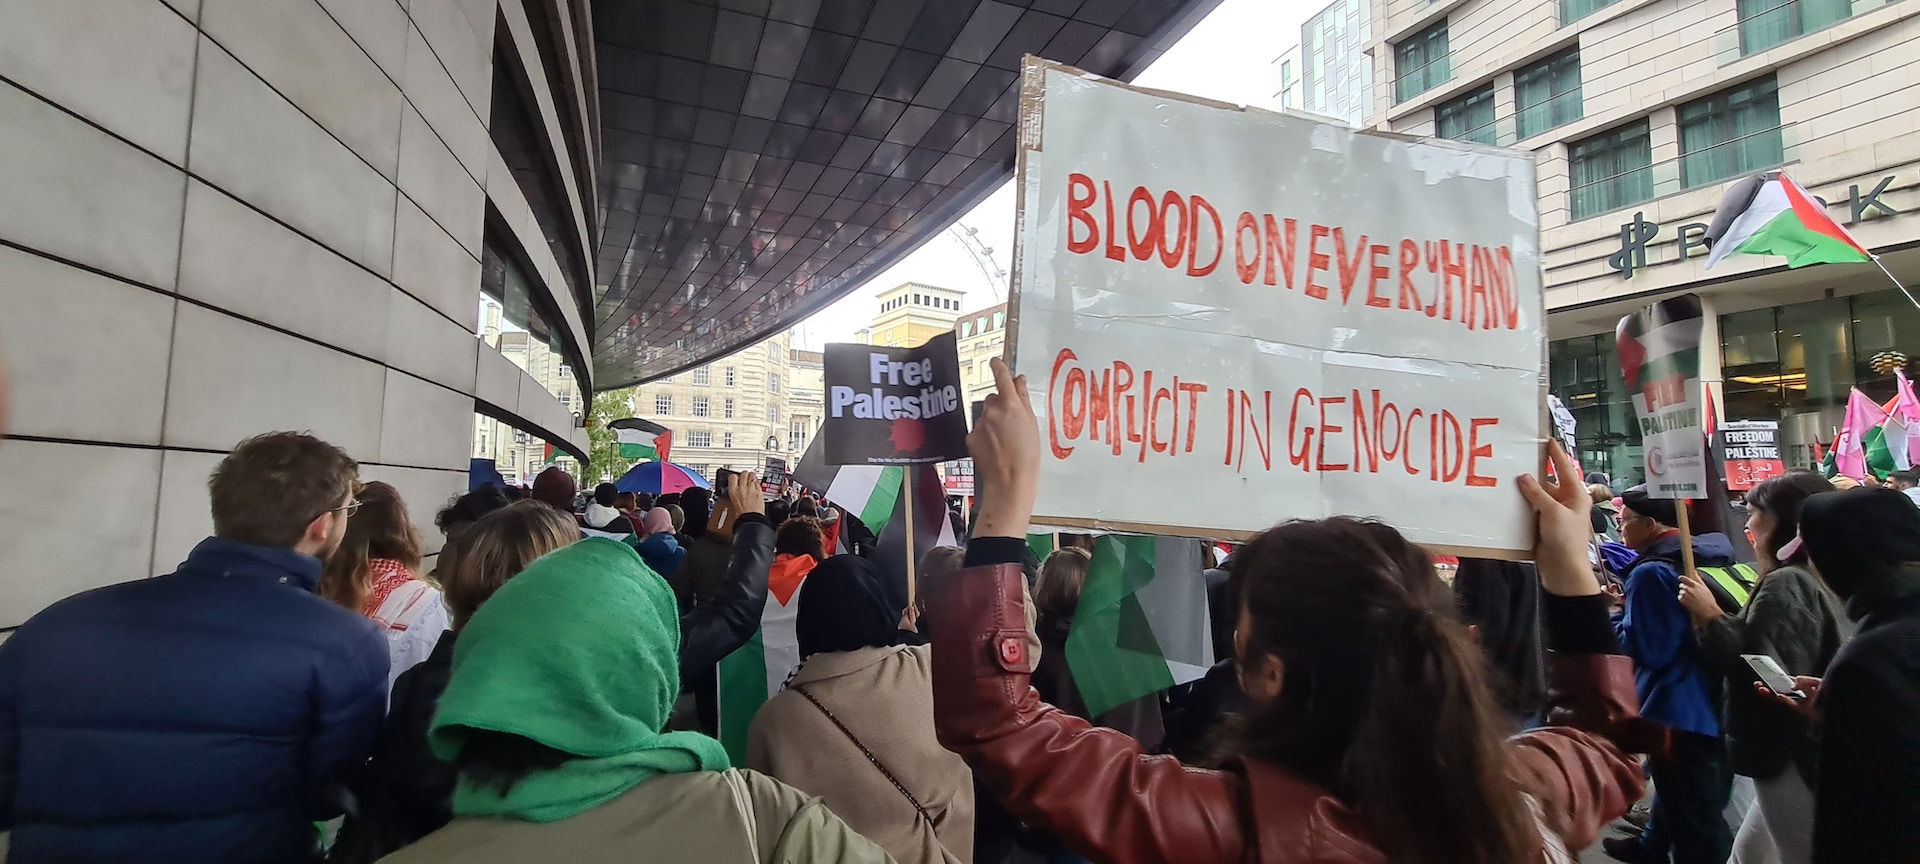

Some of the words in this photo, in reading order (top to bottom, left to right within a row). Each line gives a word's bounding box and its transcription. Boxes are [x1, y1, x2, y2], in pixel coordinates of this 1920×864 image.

[1066, 173, 1224, 278] BLOOD
[1235, 211, 1297, 289] ON
[869, 352, 933, 387] Free
[830, 385, 958, 421] Palestine
[1048, 348, 1208, 463] COMPLICIT
[1224, 389, 1272, 473] IN
[1287, 388, 1500, 488] GENOCIDE
[1725, 431, 1774, 443] FREEDOM
[1725, 447, 1779, 459] PALESTINE
